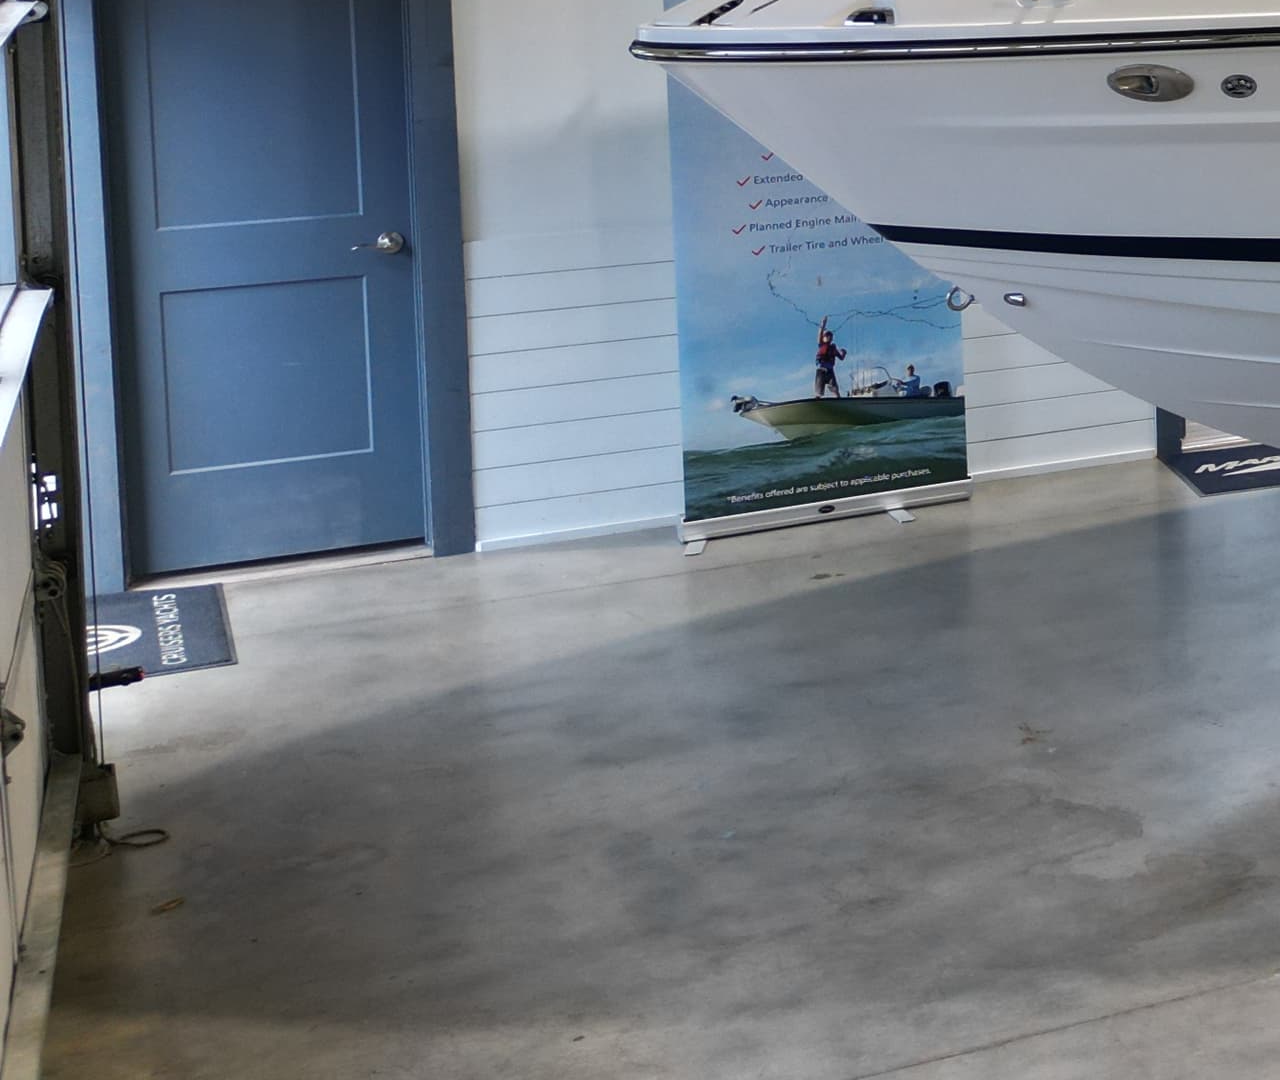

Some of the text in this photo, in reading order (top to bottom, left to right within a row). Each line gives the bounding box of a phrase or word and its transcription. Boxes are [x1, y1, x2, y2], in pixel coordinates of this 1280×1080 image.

[765, 195, 829, 208] Appearance
[749, 220, 793, 233] Planned
[795, 217, 831, 230] Engine
[769, 234, 884, 254] Trailer Tire and Wheel
[765, 486, 794, 498] offered
[796, 486, 808, 494] are
[810, 481, 839, 493] subject
[840, 479, 849, 488] to
[850, 473, 890, 486] applicable
[152, 593, 188, 666] CRUISERS YACHTS
